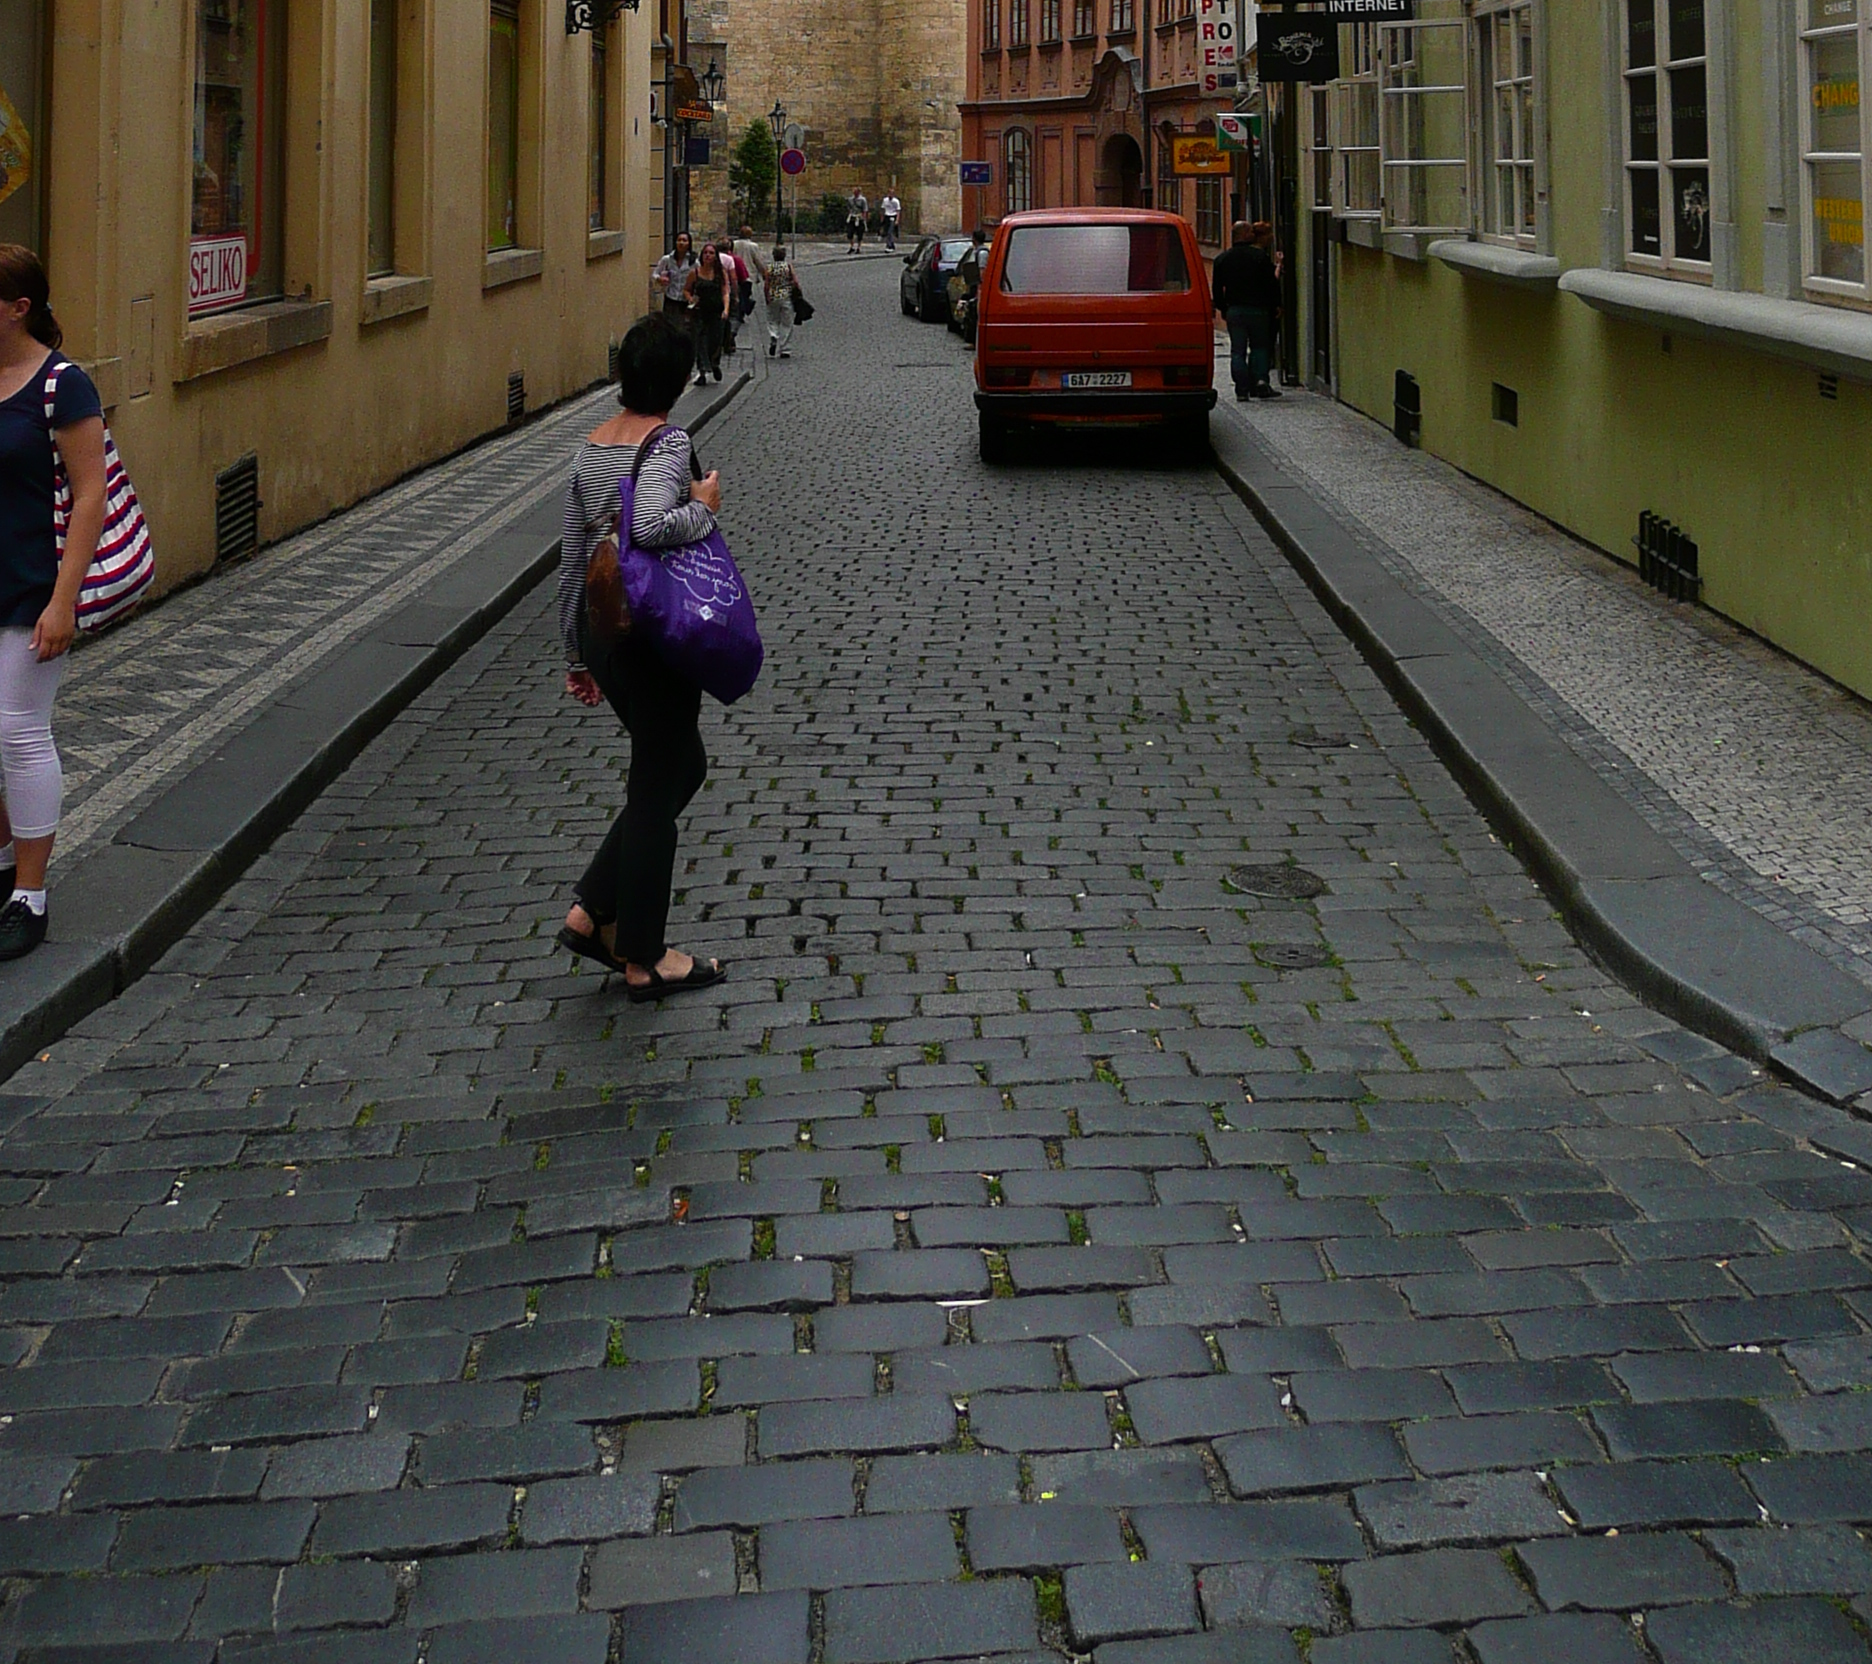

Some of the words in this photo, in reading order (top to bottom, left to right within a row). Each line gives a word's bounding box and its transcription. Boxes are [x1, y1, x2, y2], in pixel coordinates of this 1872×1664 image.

[1824, 0, 1852, 15] CHANGE
[1813, 83, 1860, 107] CHANG
[189, 245, 243, 299] SELIKO
[1070, 374, 1091, 386] 6A7
[1099, 373, 1126, 386] 2227
